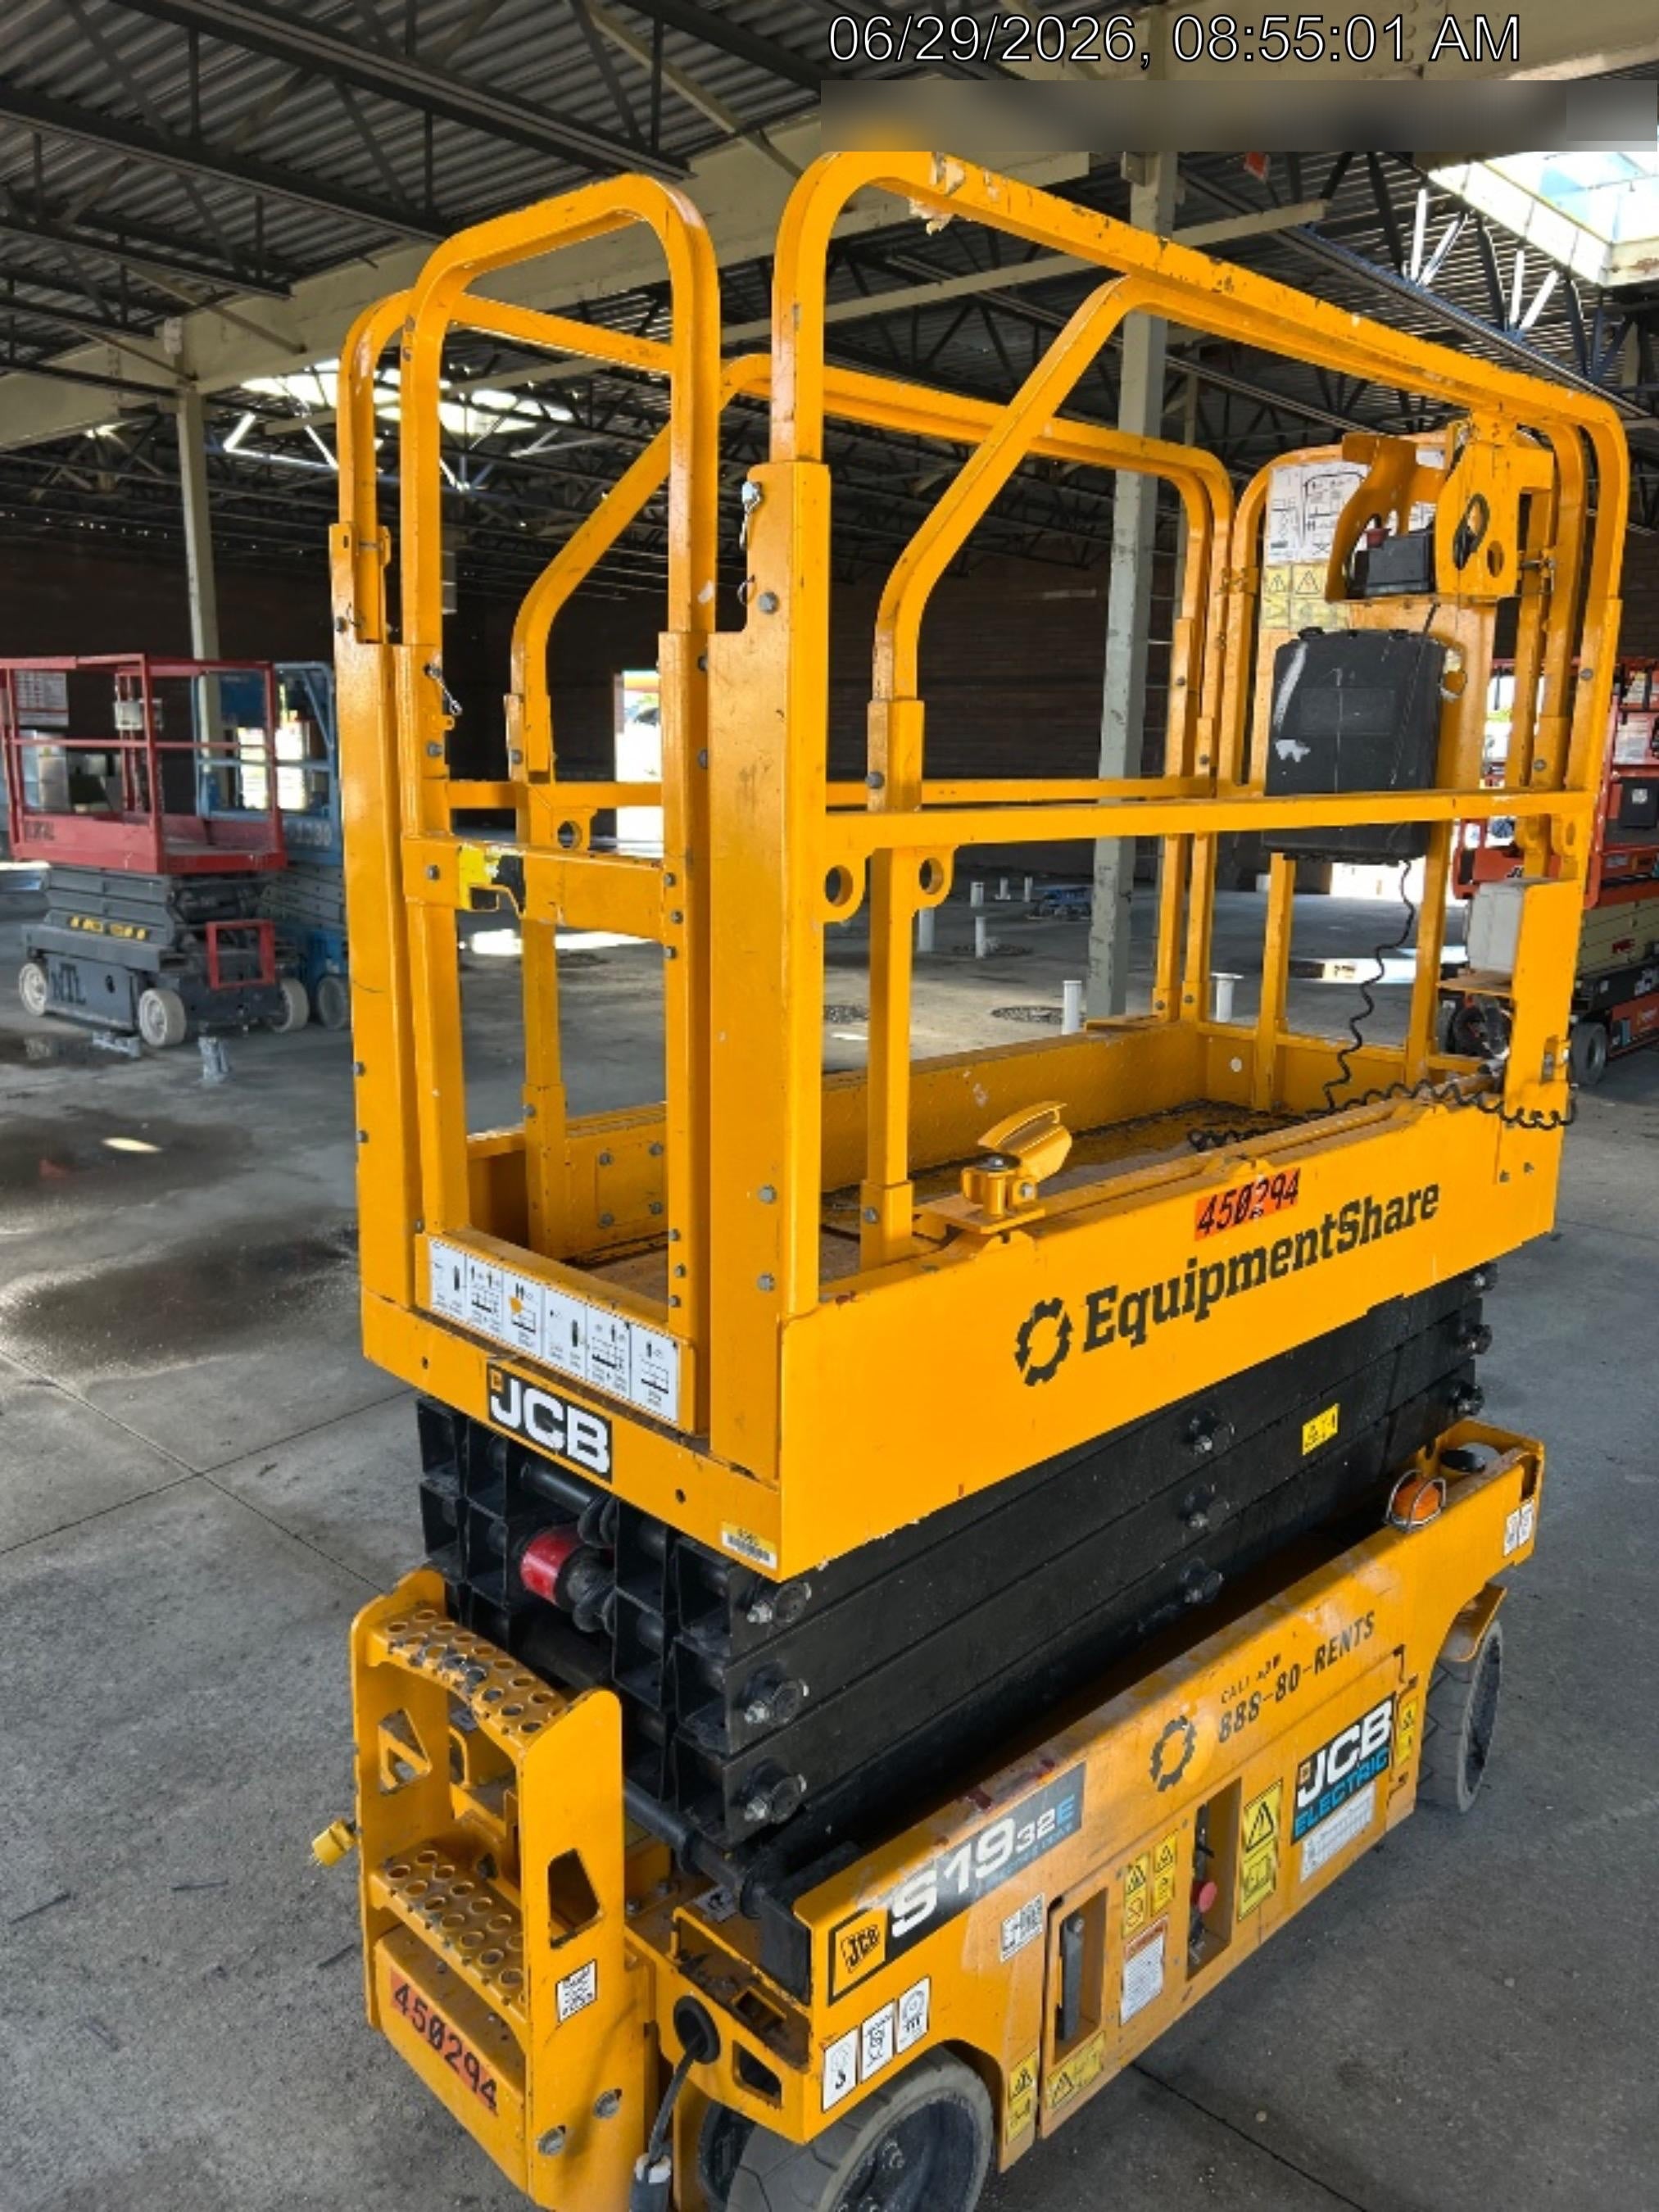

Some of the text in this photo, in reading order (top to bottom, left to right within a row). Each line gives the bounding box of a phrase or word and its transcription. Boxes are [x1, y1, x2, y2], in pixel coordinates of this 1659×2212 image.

[1197, 1167, 1301, 1235] 450294
[1082, 1182, 1440, 1353] EquipmentShare
[490, 1377, 610, 1474] JCB
[1294, 1746, 1389, 1838] ELECTRIC
[1297, 1699, 1393, 1808] JCB
[843, 1926, 881, 1969] JCB
[393, 1981, 499, 2118] 450294
